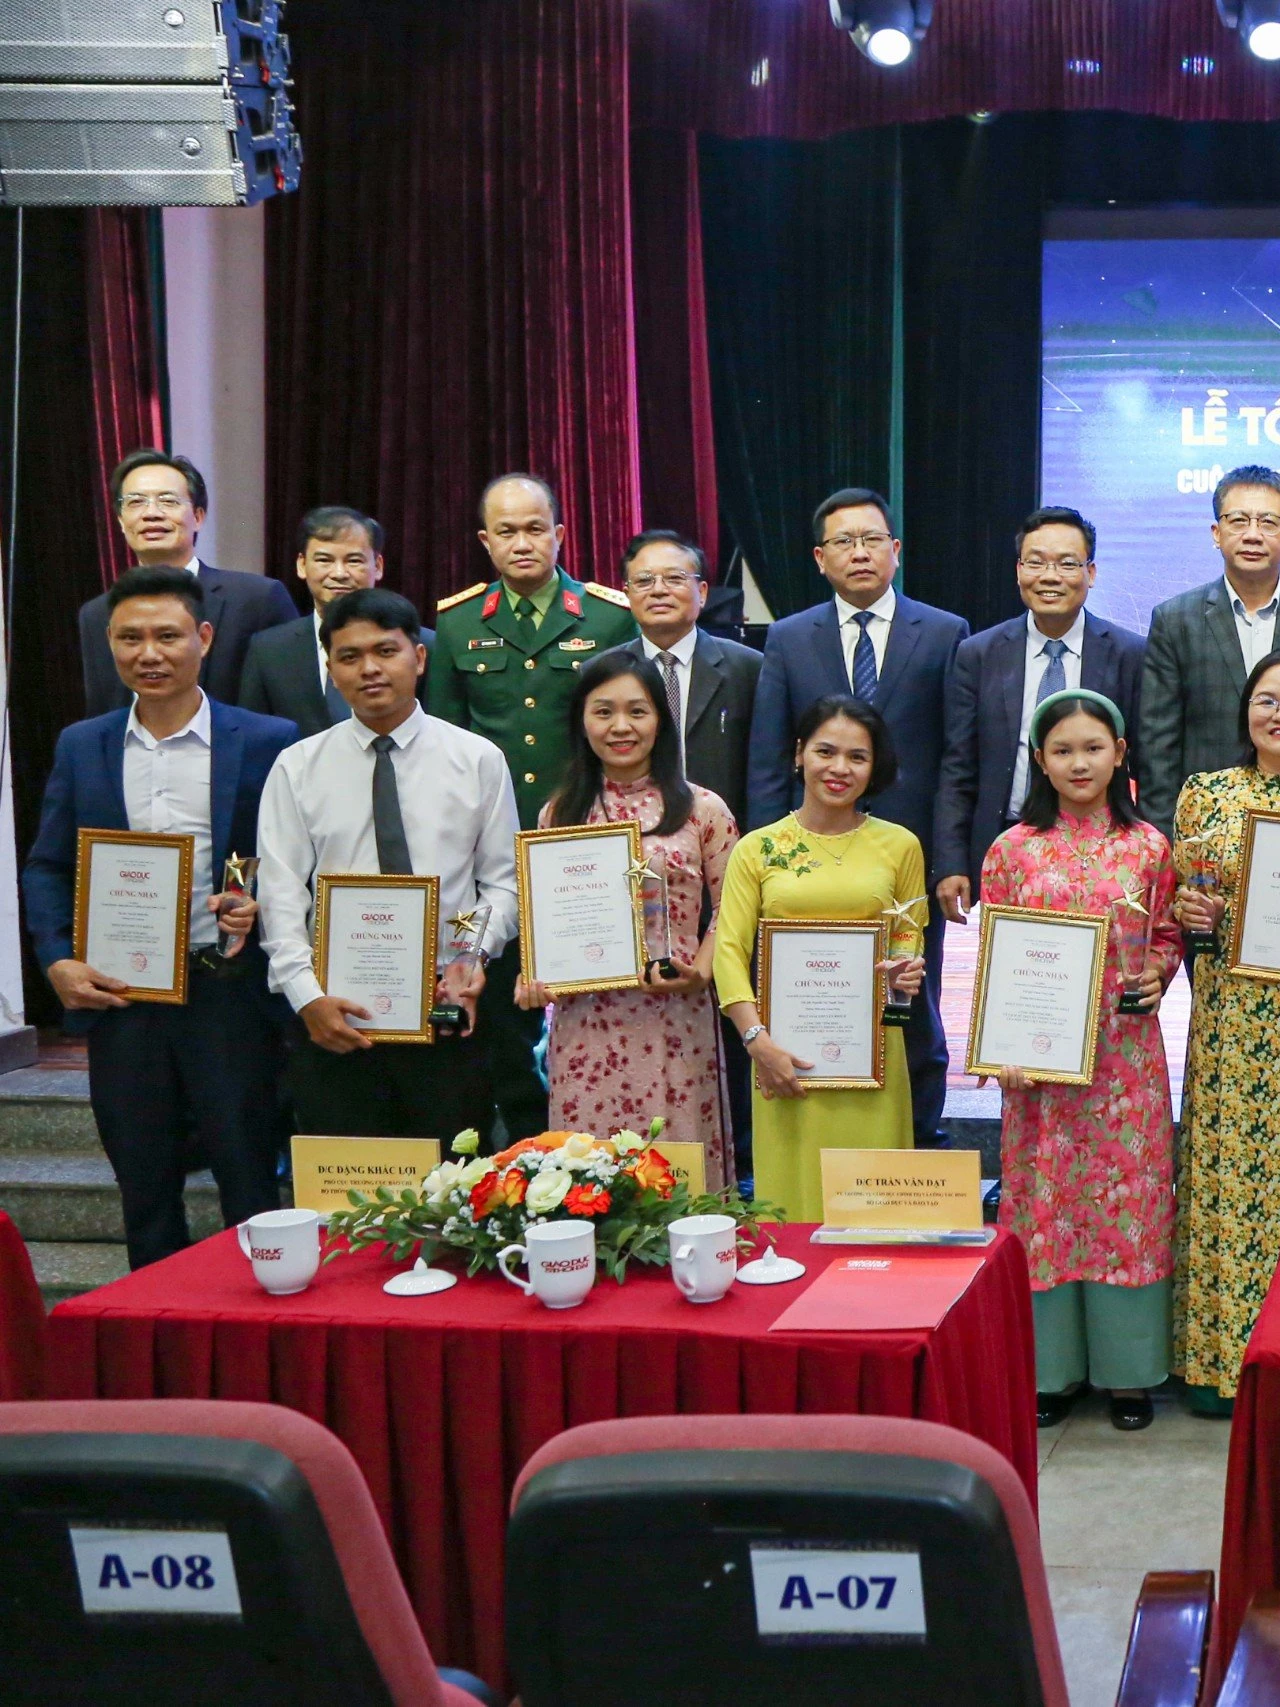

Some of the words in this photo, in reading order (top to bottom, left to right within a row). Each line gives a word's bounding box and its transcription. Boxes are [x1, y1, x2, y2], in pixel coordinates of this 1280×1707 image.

[1181, 388, 1229, 446] LỄ
[856, 1178, 872, 1186] Đ/C
[875, 1176, 900, 1187] TRẦN
[904, 1178, 923, 1187] VĂN
[926, 1179, 946, 1188] ĐẠT
[98, 1553, 215, 1590] A-08
[779, 1575, 897, 1610] A-07
